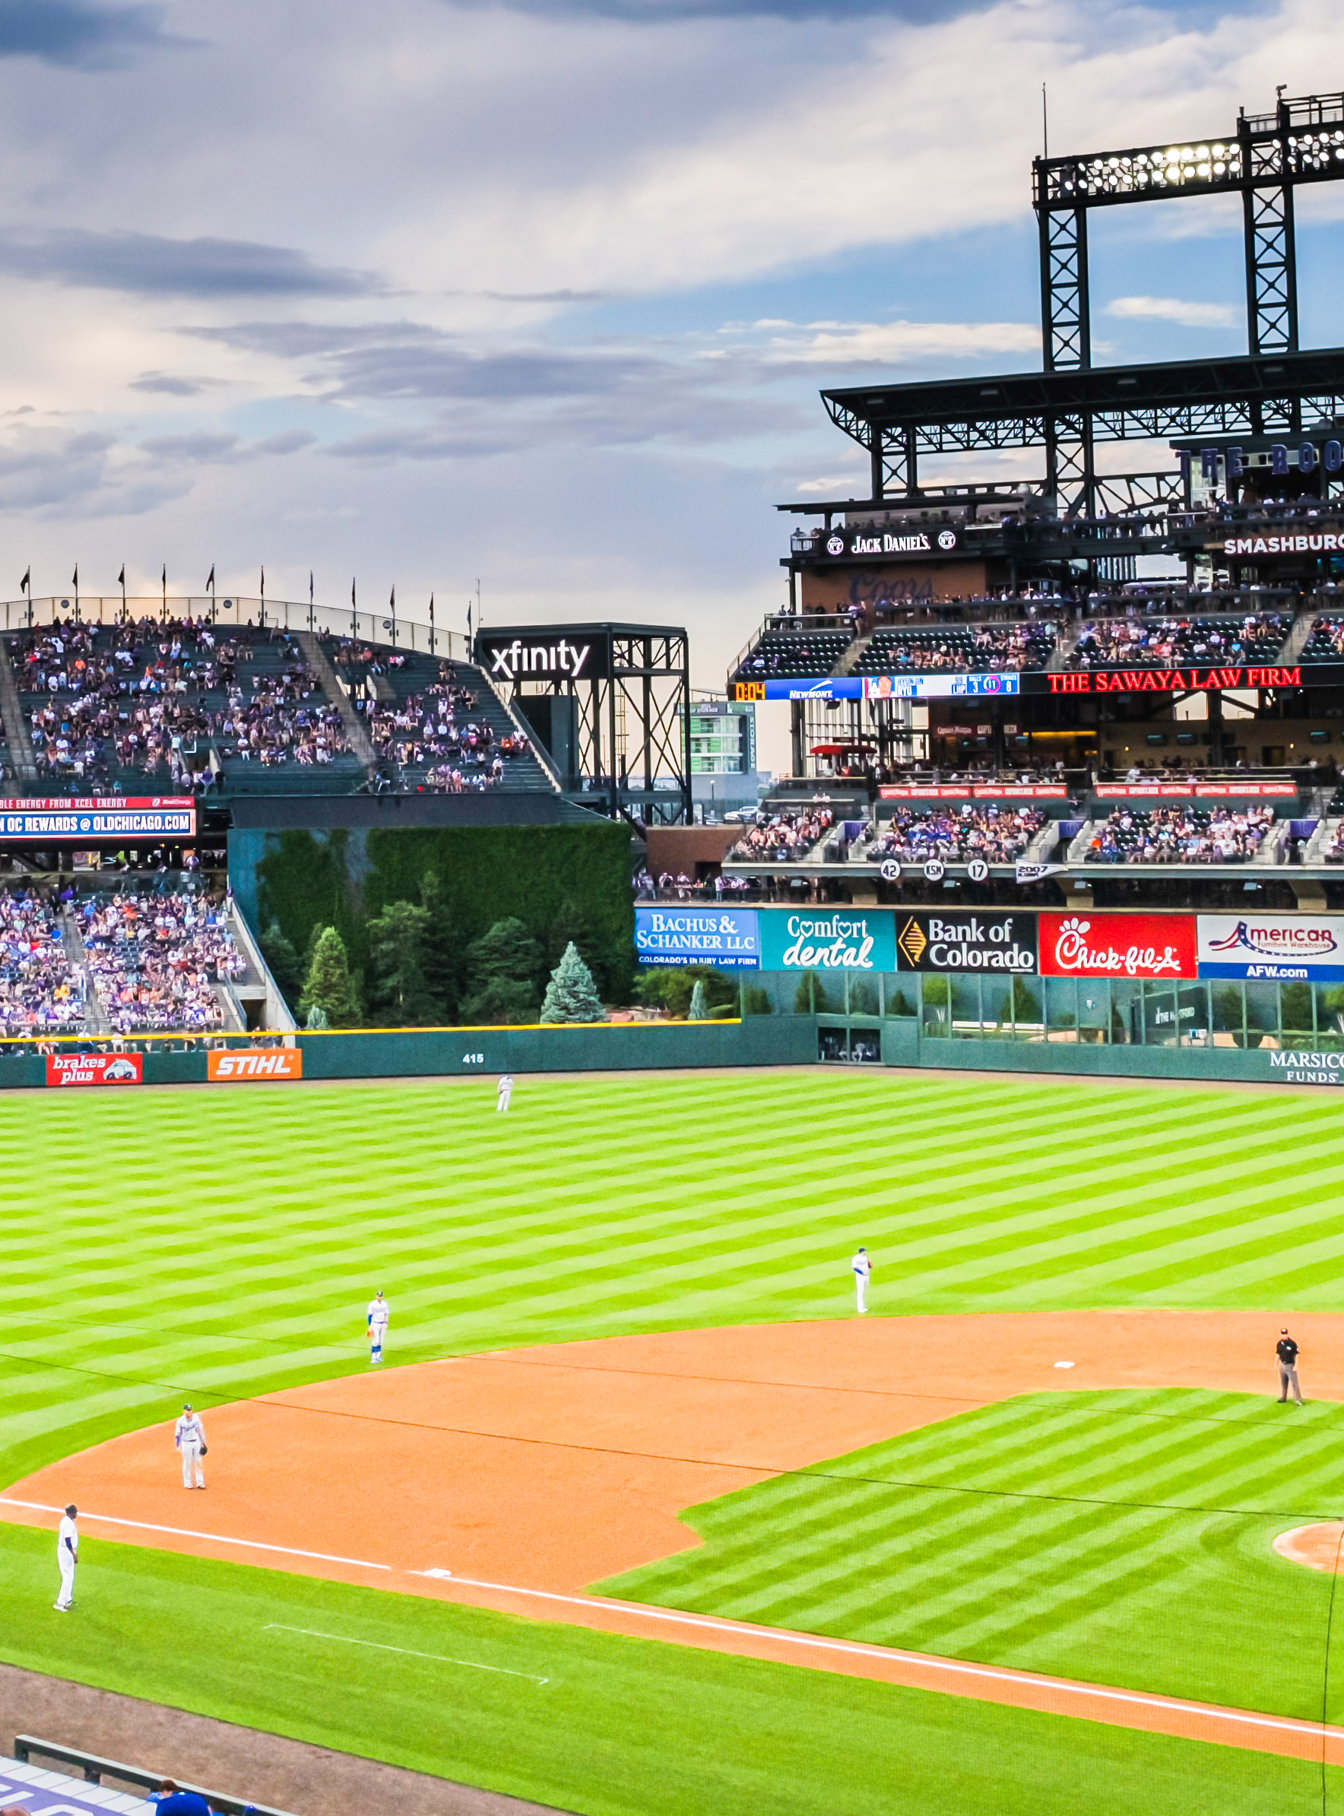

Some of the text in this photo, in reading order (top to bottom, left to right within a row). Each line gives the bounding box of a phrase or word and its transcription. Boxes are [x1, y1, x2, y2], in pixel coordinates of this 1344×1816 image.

[851, 535, 882, 554] JACK
[491, 639, 590, 679] xfinity
[1049, 667, 1302, 693] THE SAWAYA LAW FIRM
[735, 682, 765, 700] 0:04
[789, 689, 833, 699] NEWMONT
[16, 798, 46, 809] ENERGY
[49, 798, 72, 809] FROM
[74, 798, 95, 809] XCEL
[96, 797, 127, 808] ENERGY
[7, 816, 23, 833] OC
[25, 815, 78, 833] REWARDS
[80, 817, 91, 831] @
[93, 814, 190, 832] OLDCHICAGO.COM
[882, 864, 897, 877] 42
[971, 864, 984, 877] 17
[1018, 865, 1048, 873] 2007
[651, 914, 739, 934] BACHUS &
[787, 915, 868, 938] Comfort
[929, 919, 1013, 943] Bank of
[637, 930, 755, 950] SCHANKER LLC
[782, 935, 873, 968] dental
[929, 943, 1035, 969] Colorado
[1056, 929, 1181, 974] Chick-fil-A
[719, 957, 739, 966] LAW
[1246, 965, 1308, 979] AFW.com
[53, 1055, 106, 1070] brakes
[216, 1054, 292, 1075] STIHL
[462, 1053, 485, 1065] 415
[60, 1068, 94, 1084] plus
[1286, 1070, 1337, 1083] FUNDS
